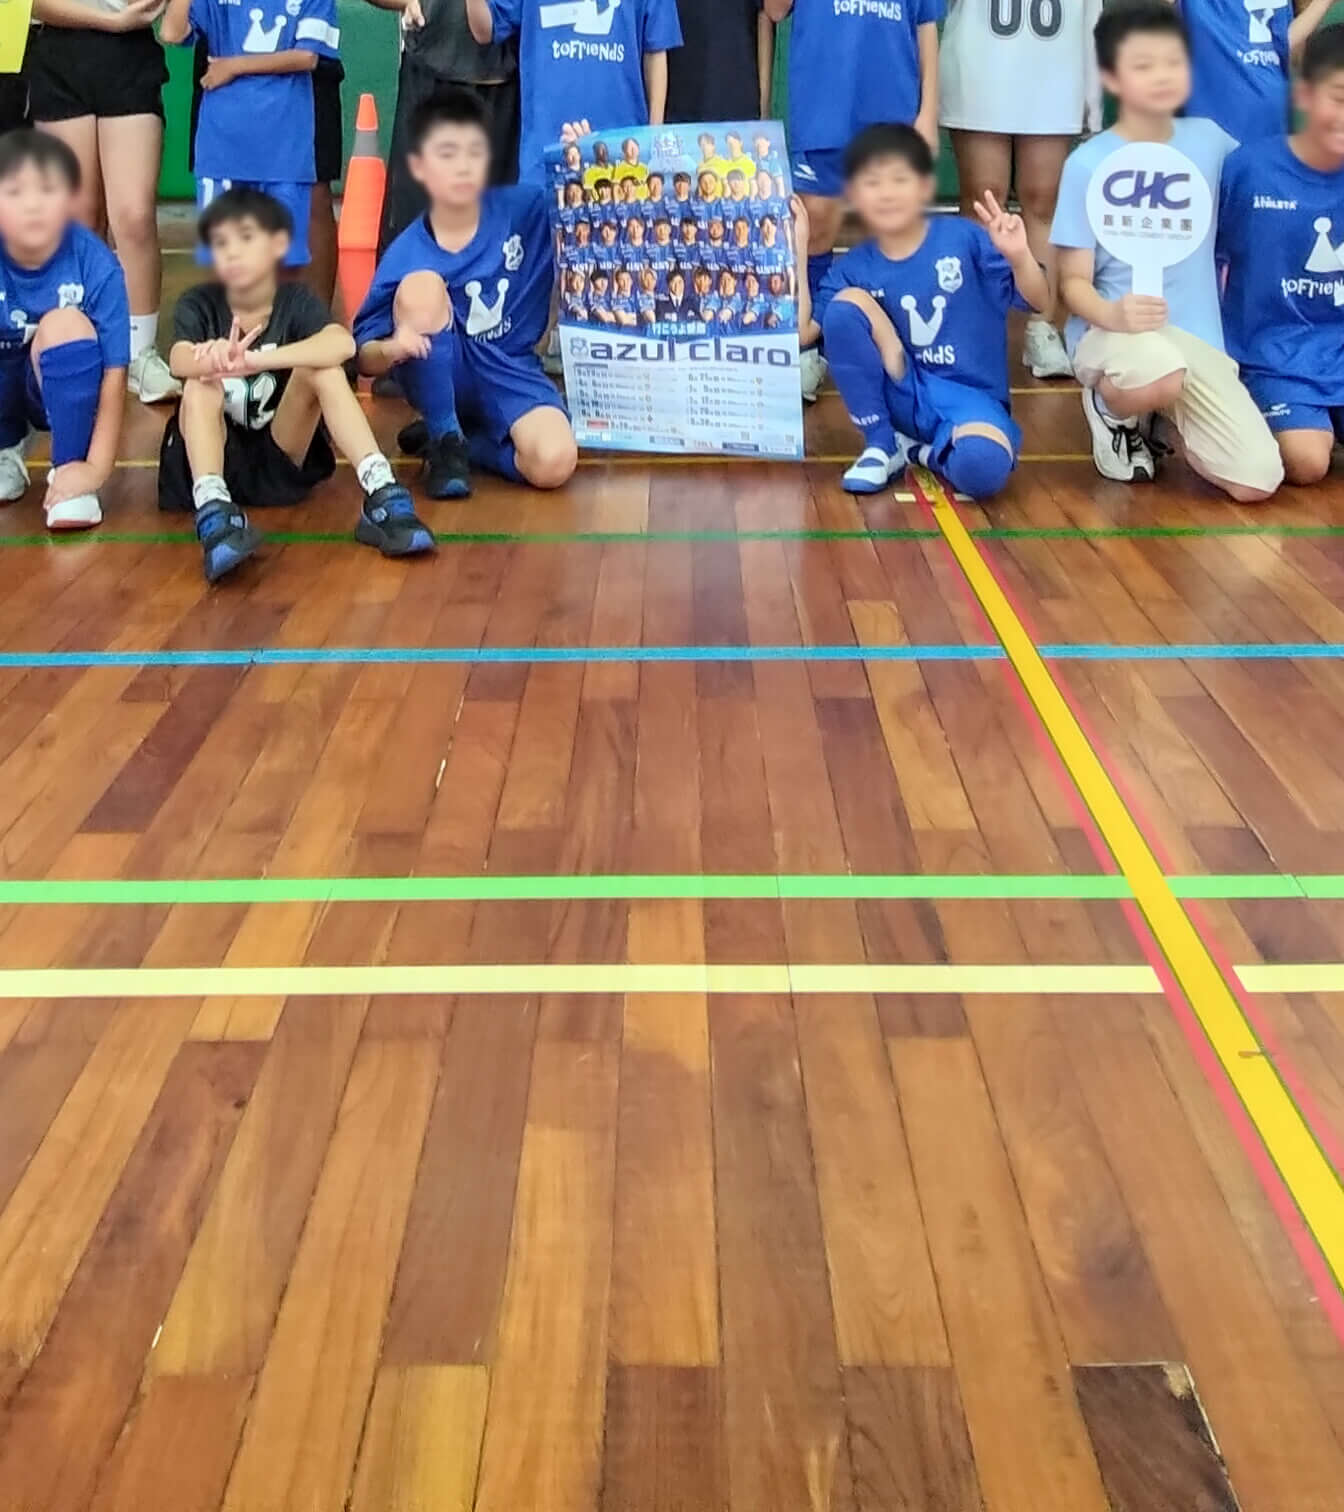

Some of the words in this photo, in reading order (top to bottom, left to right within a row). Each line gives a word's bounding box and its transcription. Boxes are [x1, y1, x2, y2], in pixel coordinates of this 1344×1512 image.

[1102, 170, 1192, 210] CHC
[590, 336, 676, 363] azul
[688, 336, 792, 368] claro
